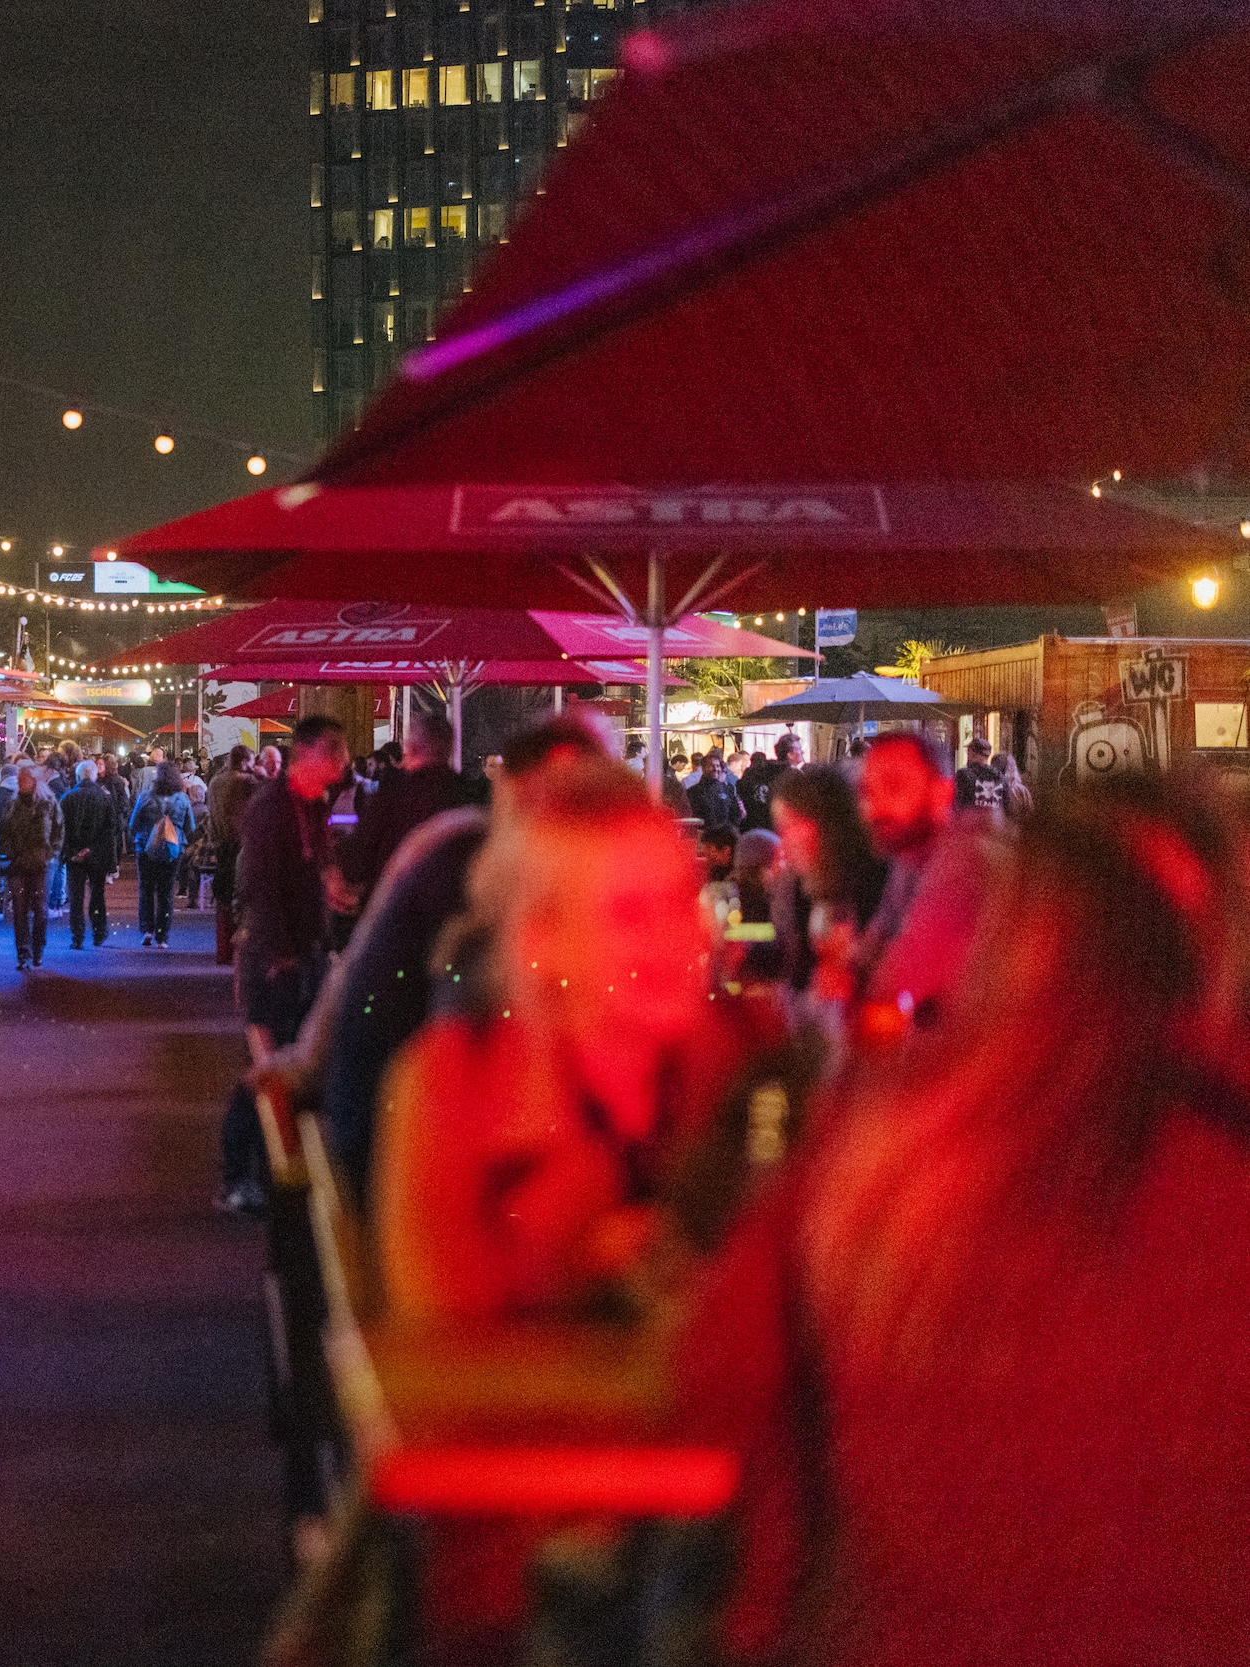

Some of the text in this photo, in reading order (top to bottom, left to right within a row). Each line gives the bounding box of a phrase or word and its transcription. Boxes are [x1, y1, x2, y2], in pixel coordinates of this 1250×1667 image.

[490, 498, 849, 522] ASTRA
[262, 627, 418, 645] ASTRA
[1129, 661, 1175, 697] WC
[86, 686, 122, 697] TSCHÜSS
